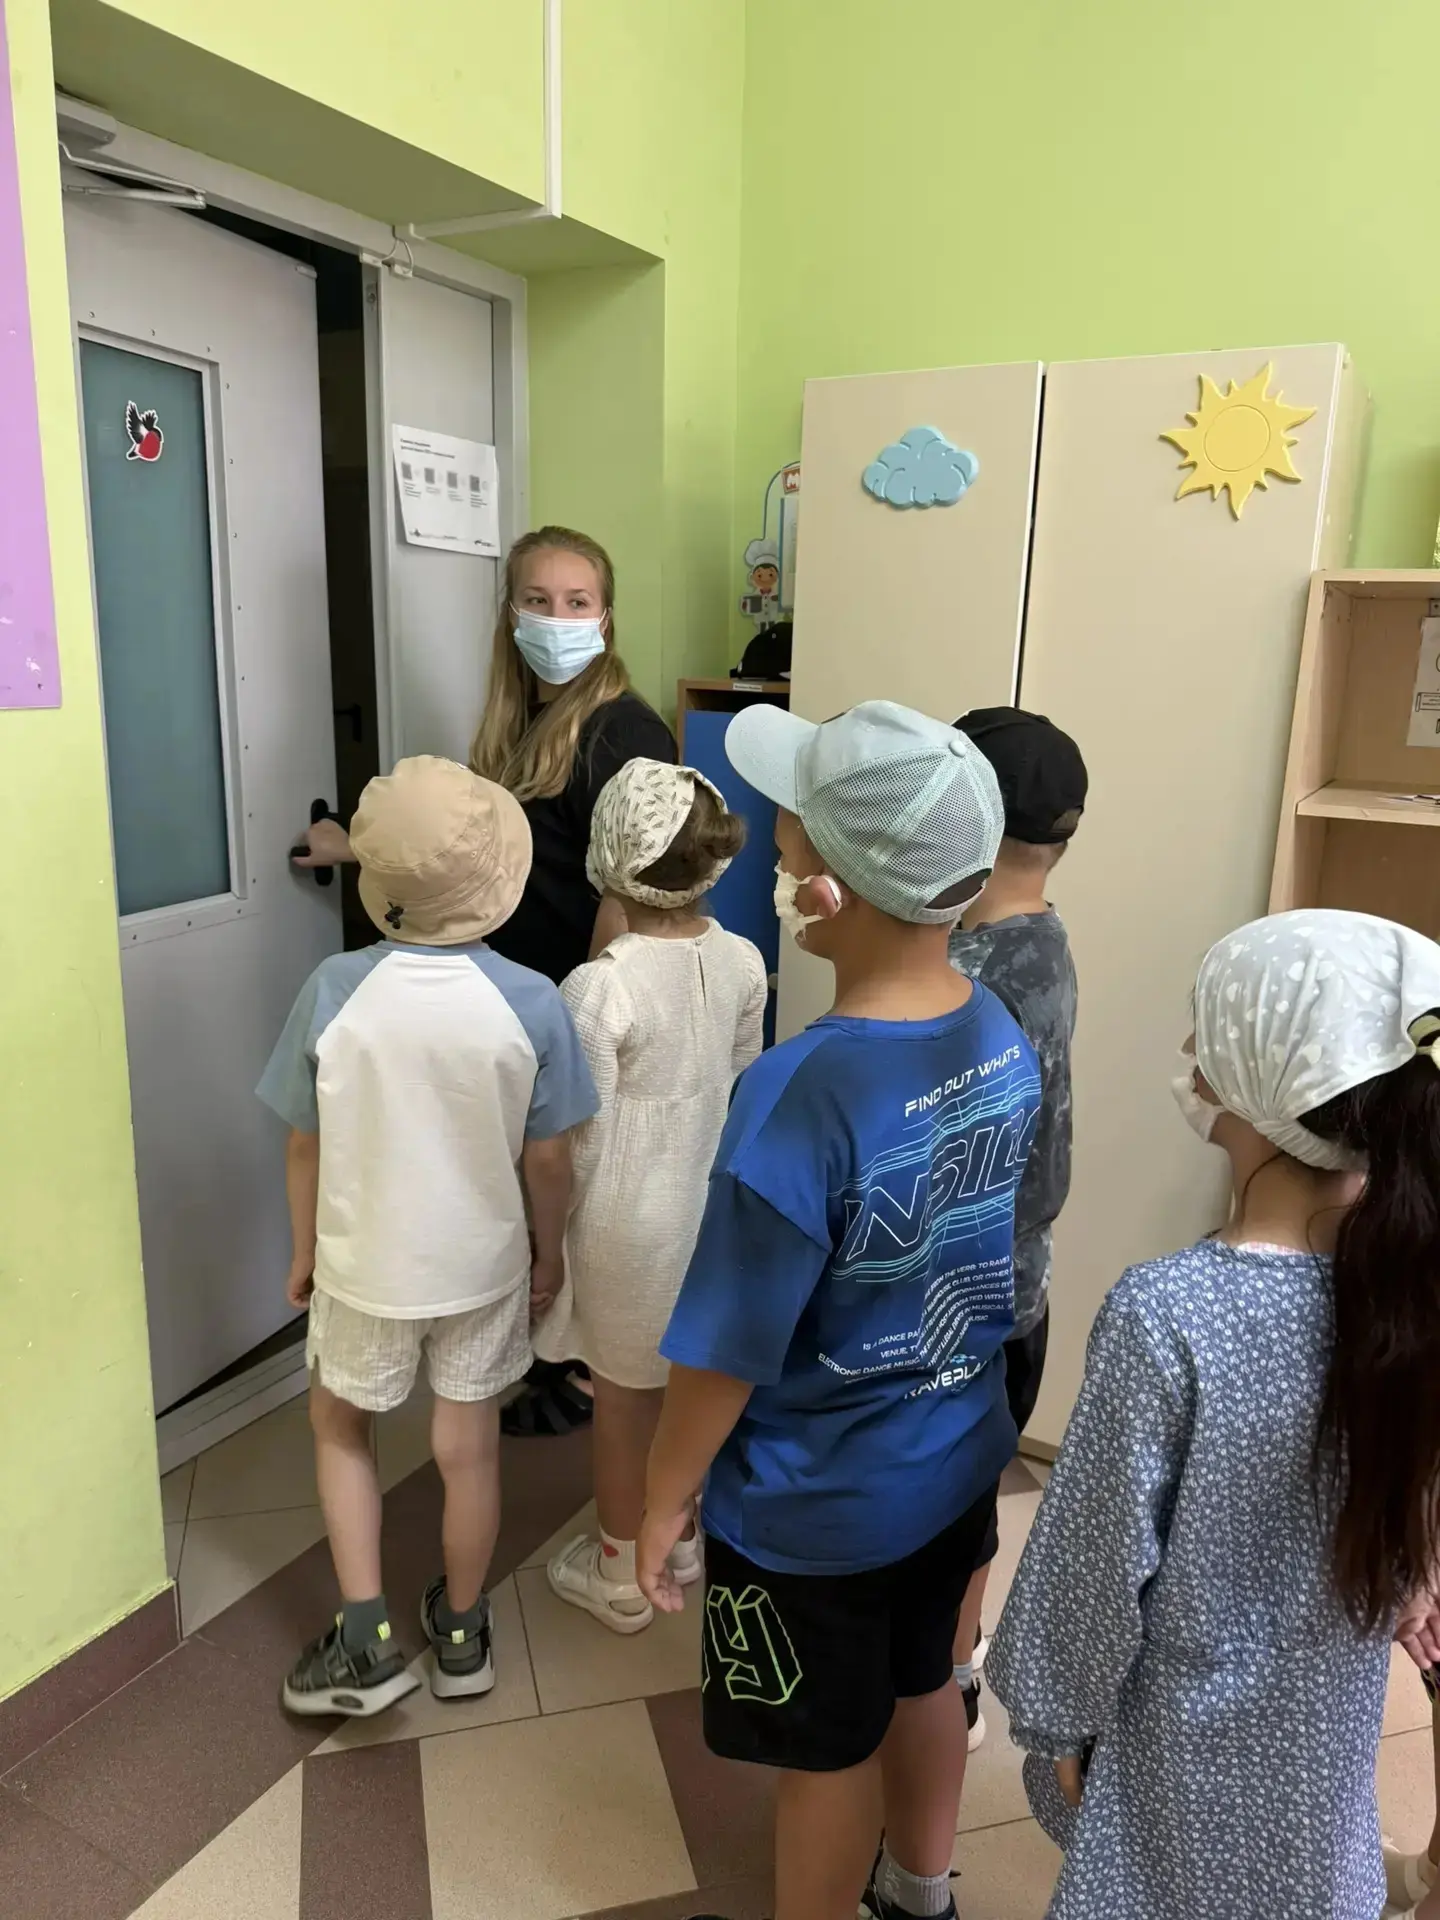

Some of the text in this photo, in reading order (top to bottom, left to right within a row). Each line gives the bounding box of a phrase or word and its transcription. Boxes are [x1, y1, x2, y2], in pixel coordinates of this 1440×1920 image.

[905, 1089, 943, 1118] FIND
[944, 1068, 974, 1094] OUT
[878, 1332, 906, 1345] DANCE
[985, 1269, 1009, 1279] OTHER
[818, 1353, 861, 1375] ELECTRONIC
[863, 1363, 891, 1374] DANCE
